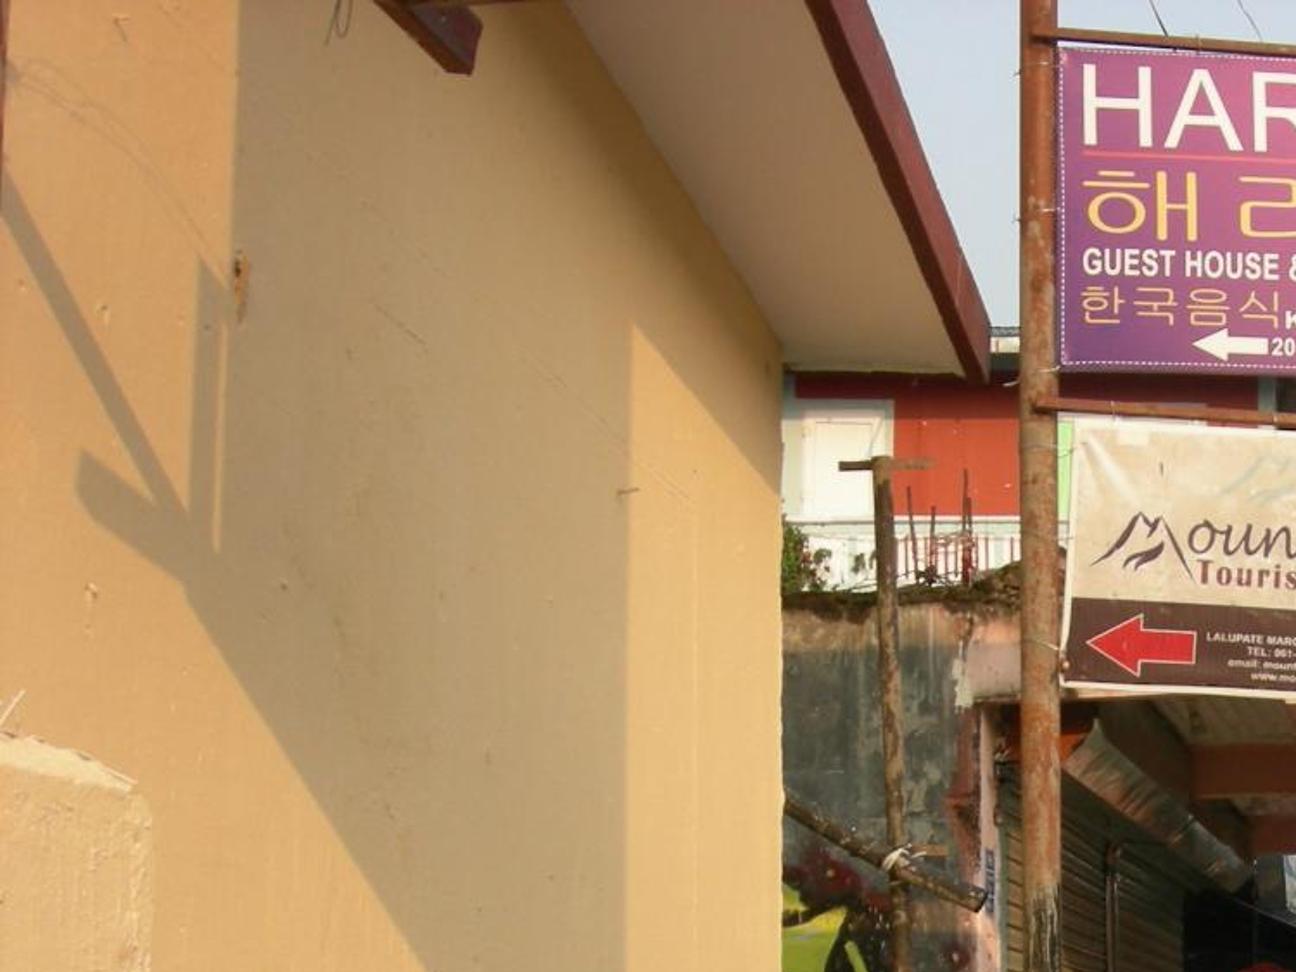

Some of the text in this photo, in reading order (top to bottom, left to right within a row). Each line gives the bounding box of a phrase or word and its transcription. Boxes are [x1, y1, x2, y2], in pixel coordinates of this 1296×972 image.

[1082, 247, 1176, 277] GUEST
[1185, 250, 1281, 281] HOUSE
[1081, 286, 1279, 330] 한국음식
[1271, 337, 1296, 356] 20
[1206, 631, 1264, 644] LALUPATE
